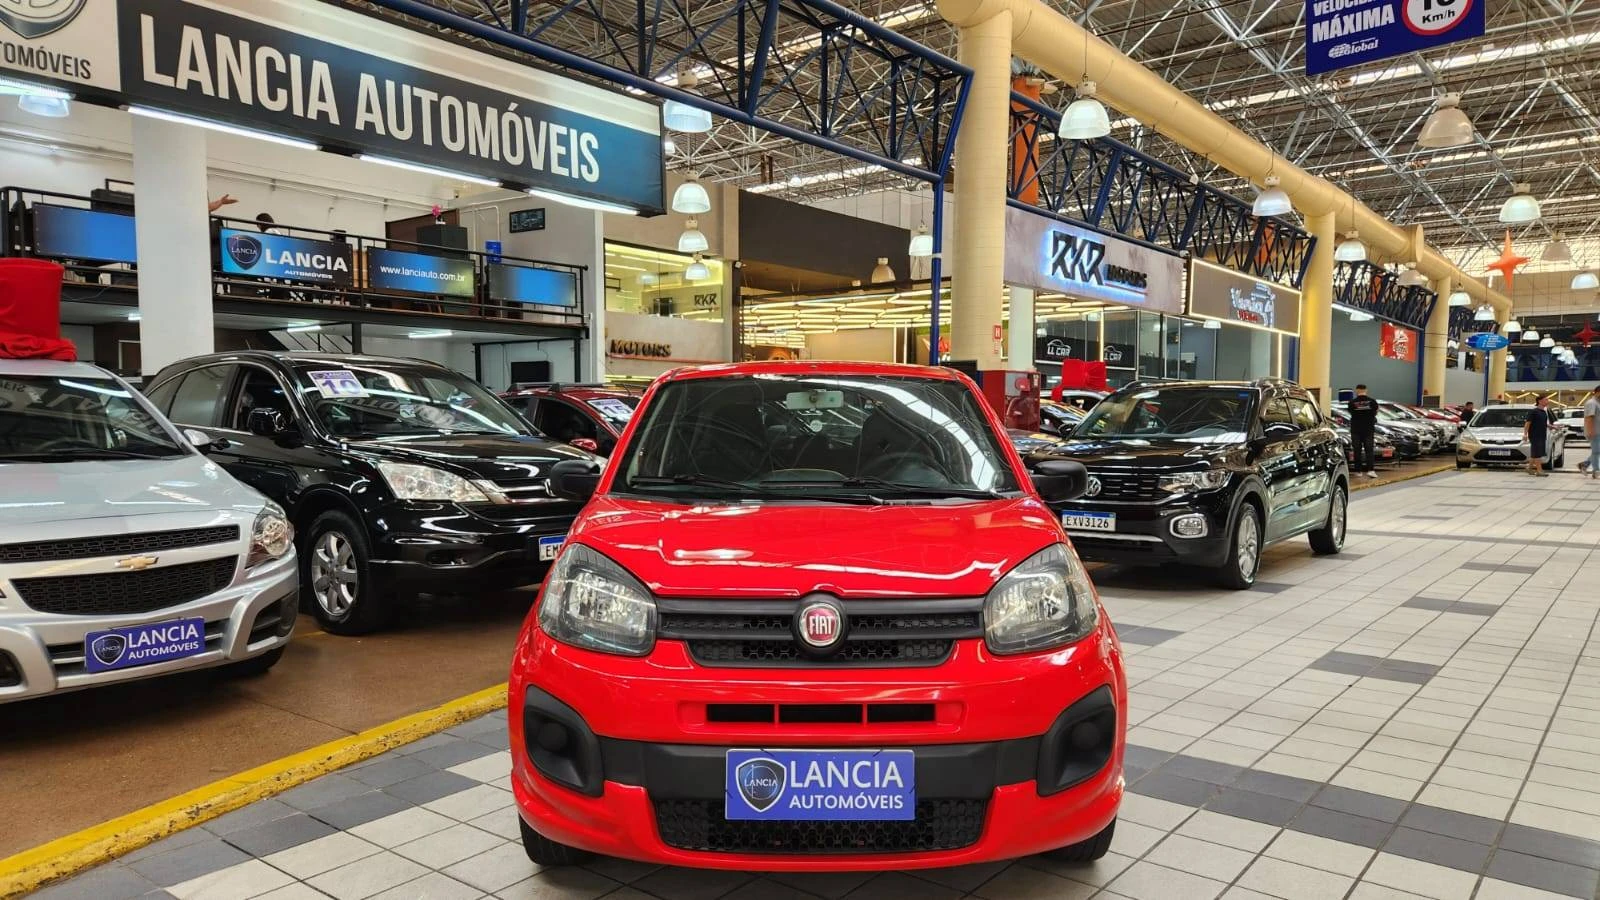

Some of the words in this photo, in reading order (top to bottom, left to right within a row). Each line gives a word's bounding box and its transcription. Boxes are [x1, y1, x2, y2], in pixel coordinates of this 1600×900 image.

[1312, 4, 1395, 43] MÁXIMA
[1422, 9, 1456, 24] Km/h
[0, 40, 92, 80] OMÓVEIS
[140, 13, 340, 126] LANCIA
[355, 72, 600, 183] AUTOMÓVEIS
[265, 248, 348, 273] LANCIA
[1052, 230, 1105, 286] RKR
[380, 265, 465, 282] www.lanciauto.com.br
[1066, 516, 1109, 529] EXV3126
[546, 544, 563, 558] EM
[809, 615, 834, 635] FIAT
[129, 624, 199, 648] LANCIA
[129, 640, 199, 660] AUTOMÓVEIS
[744, 778, 778, 787] LANCIA
[790, 760, 904, 789] LANCIA
[789, 792, 904, 809] AUTOMÓVEIS
